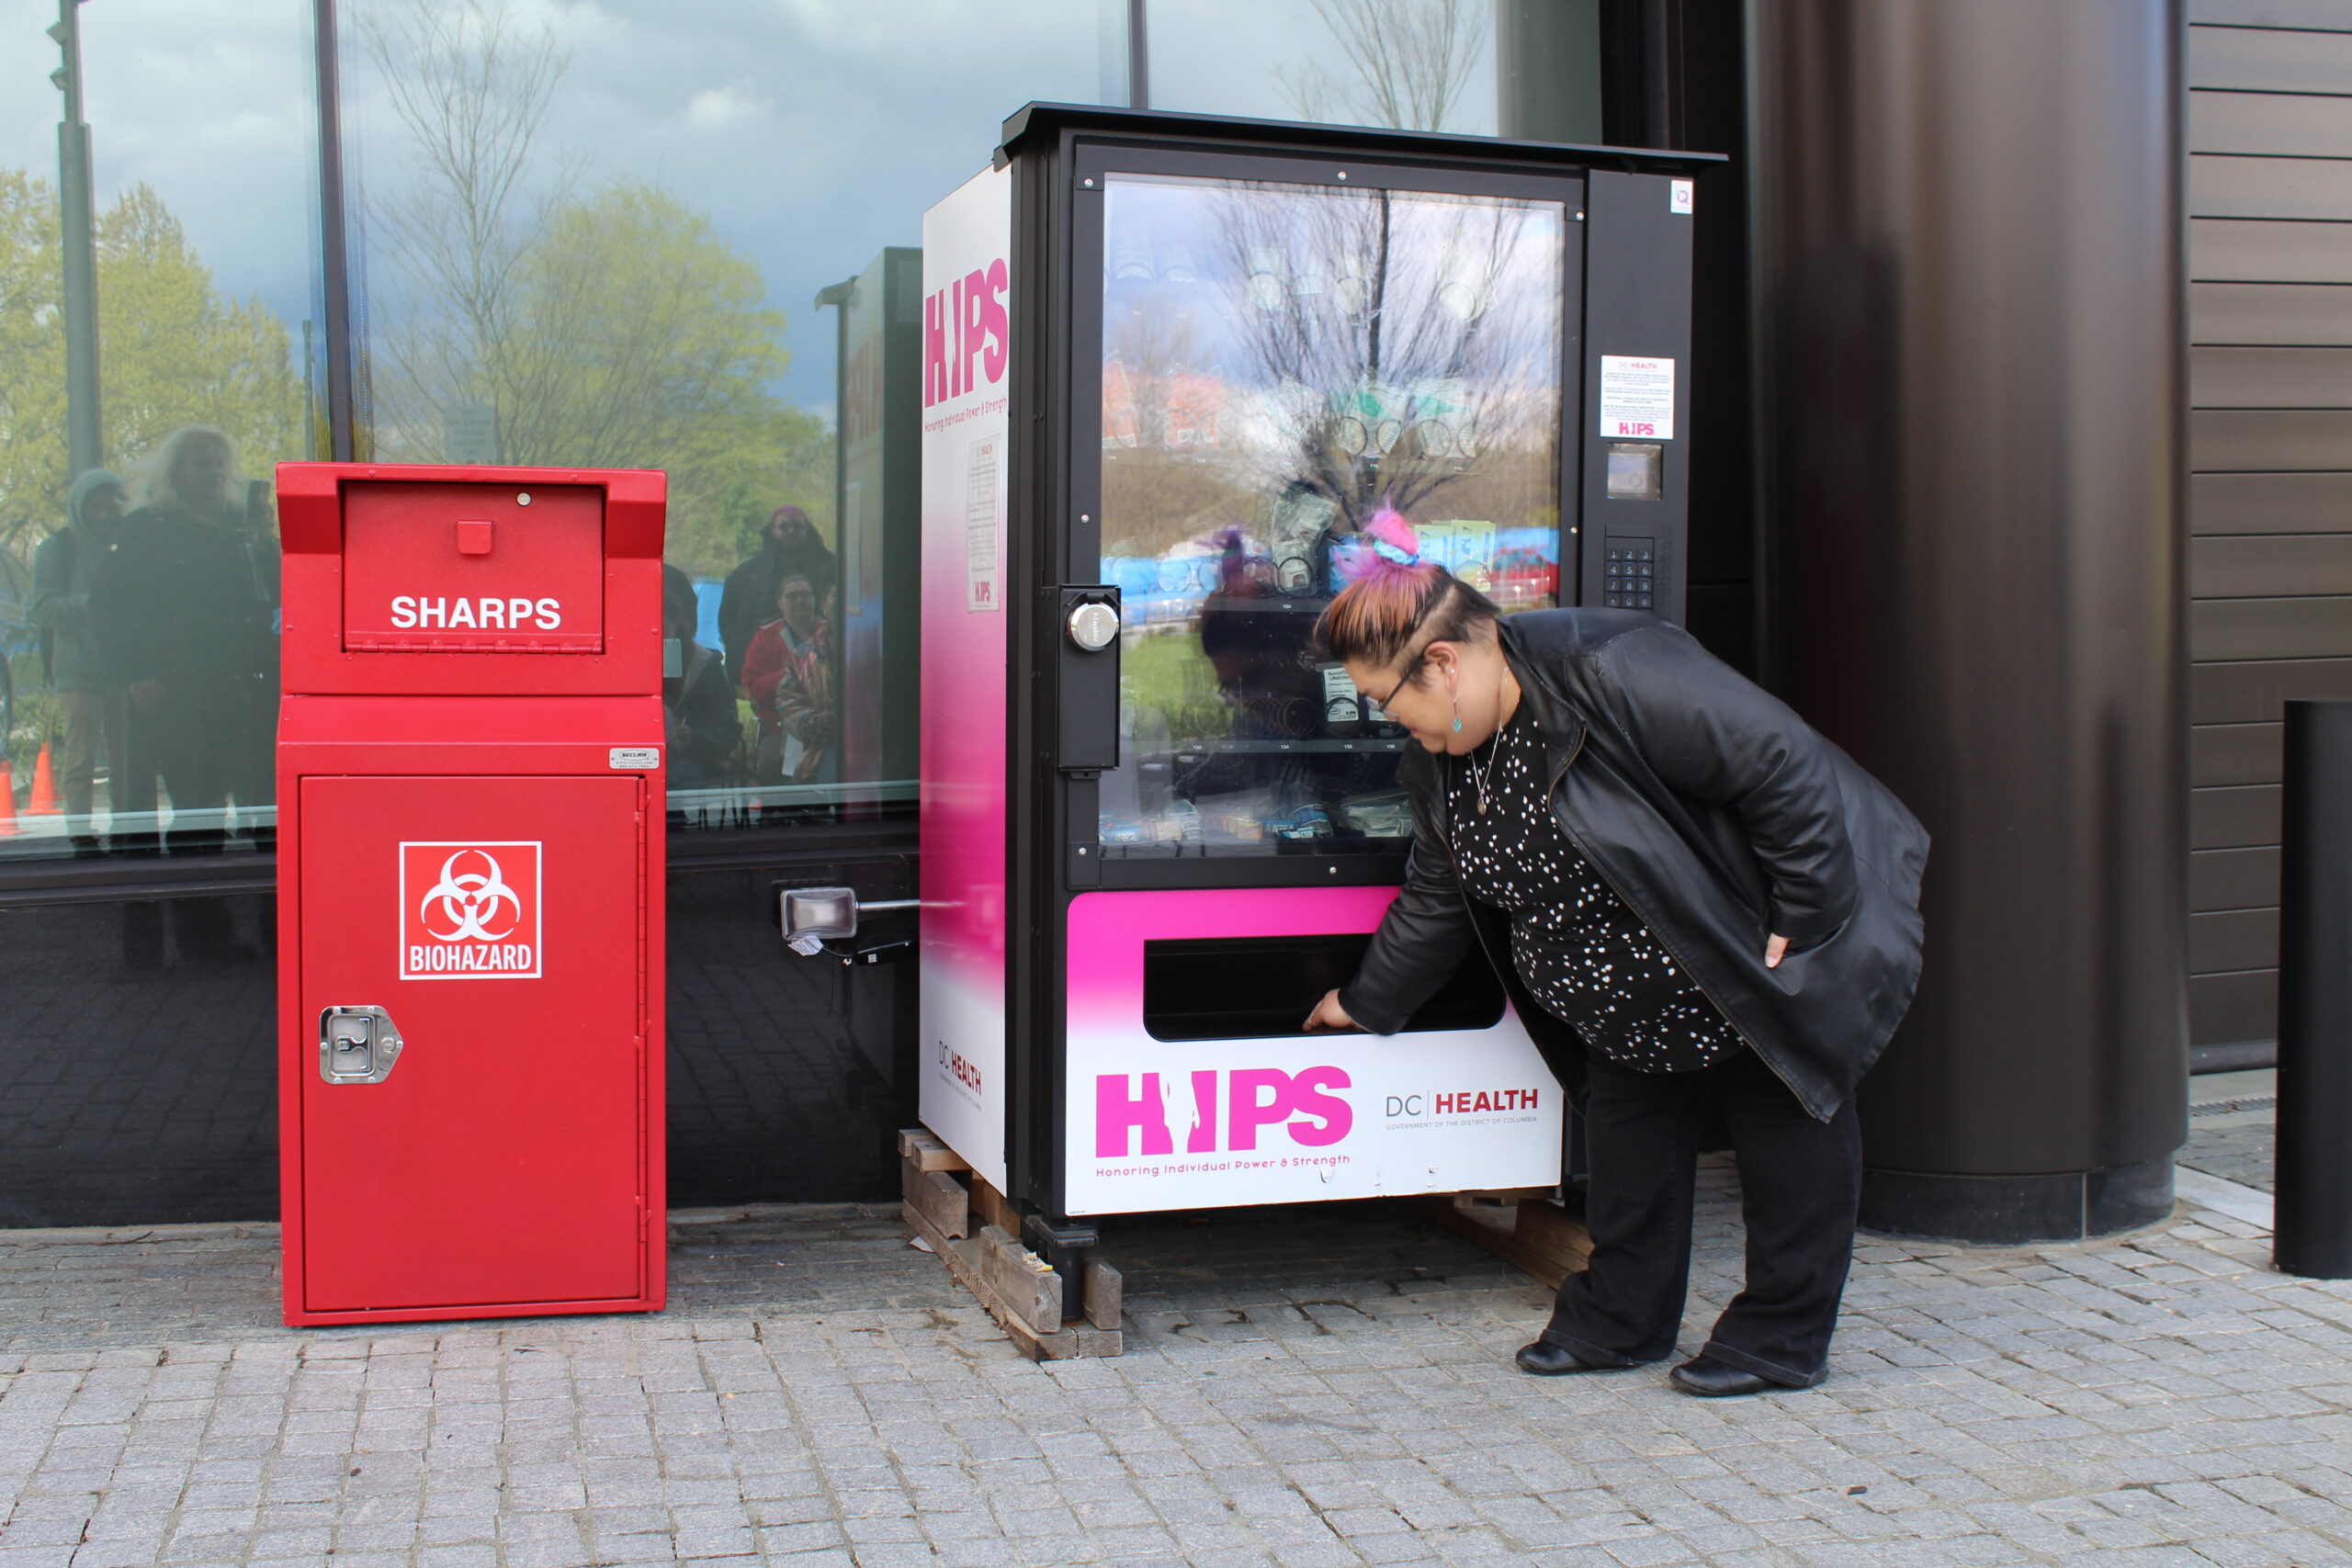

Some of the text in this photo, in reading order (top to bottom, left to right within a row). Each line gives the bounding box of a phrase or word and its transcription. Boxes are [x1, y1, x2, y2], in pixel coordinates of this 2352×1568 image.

[924, 257, 1008, 408] HIPS
[1619, 422, 1655, 435] HIPS
[390, 595, 561, 630] SHARPS
[410, 944, 532, 972] BIOHAZARD
[939, 1040, 949, 1069] DC
[951, 1050, 981, 1096] HEALTH
[1096, 1066, 1353, 1157] HIPS
[1385, 1089, 1538, 1117] DC HEALTH
[1503, 1116, 1537, 1124] COLUMBIA
[1096, 1166, 1159, 1177] Honoring
[1164, 1161, 1230, 1173] Individual
[1235, 1158, 1276, 1169] Power
[1293, 1155, 1351, 1168] Strength
